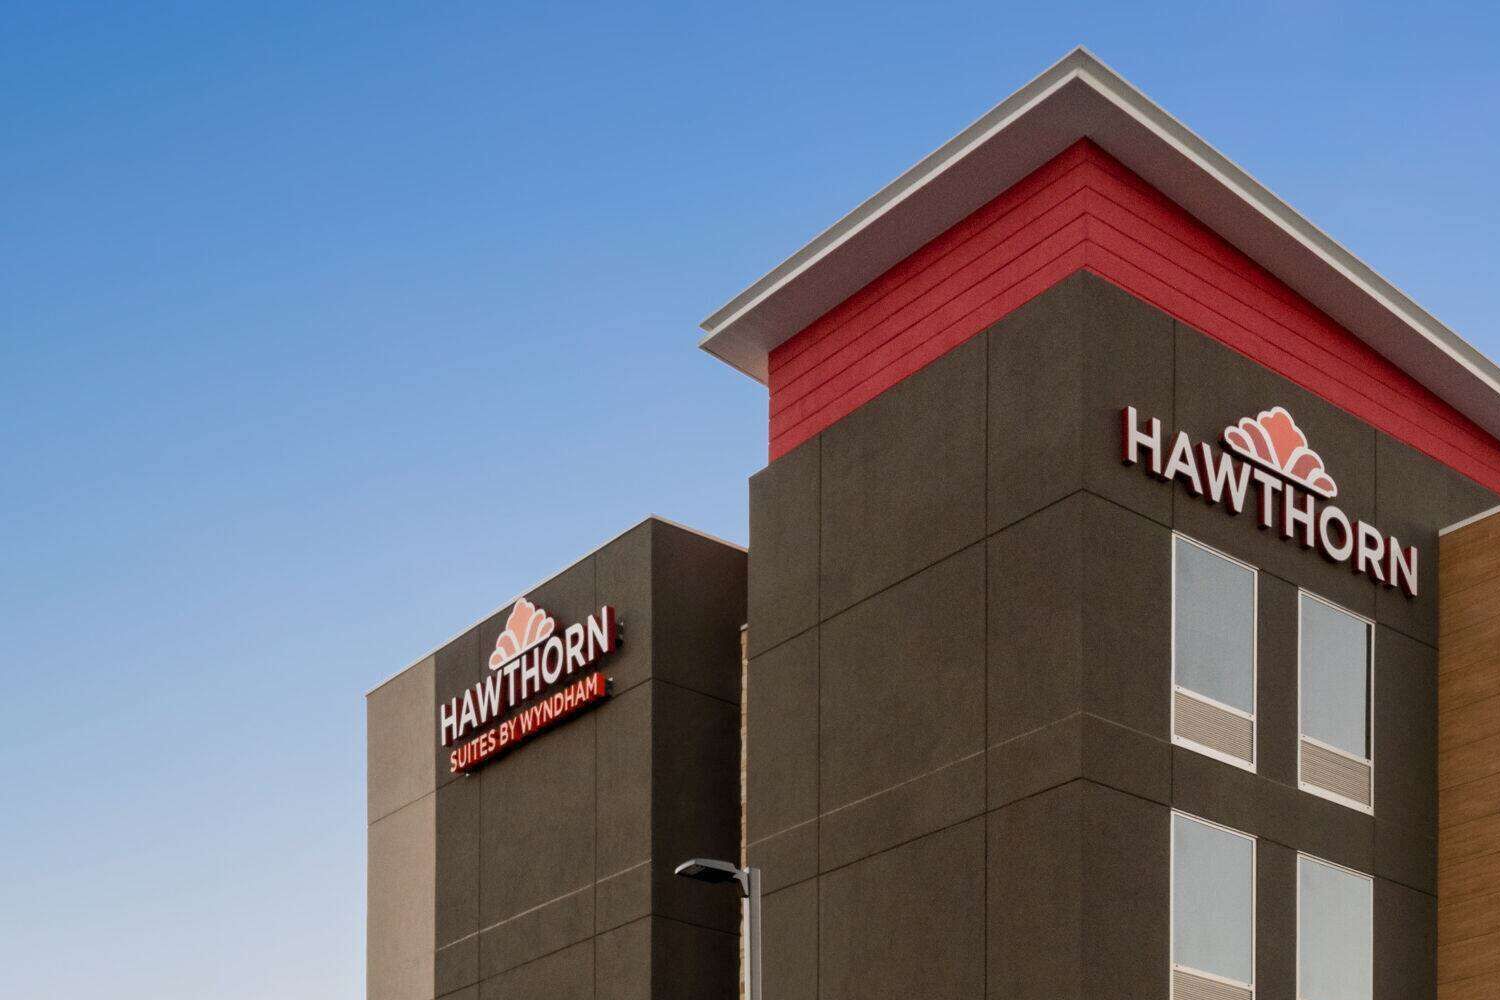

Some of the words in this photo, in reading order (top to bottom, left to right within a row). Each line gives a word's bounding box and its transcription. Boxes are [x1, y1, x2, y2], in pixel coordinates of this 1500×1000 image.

[1123, 405, 1418, 597] HAWTHORN
[440, 605, 615, 746] HAWTHORN
[450, 728, 497, 773] SUITES
[500, 715, 518, 746] BY
[520, 672, 598, 734] WYNDHAM
